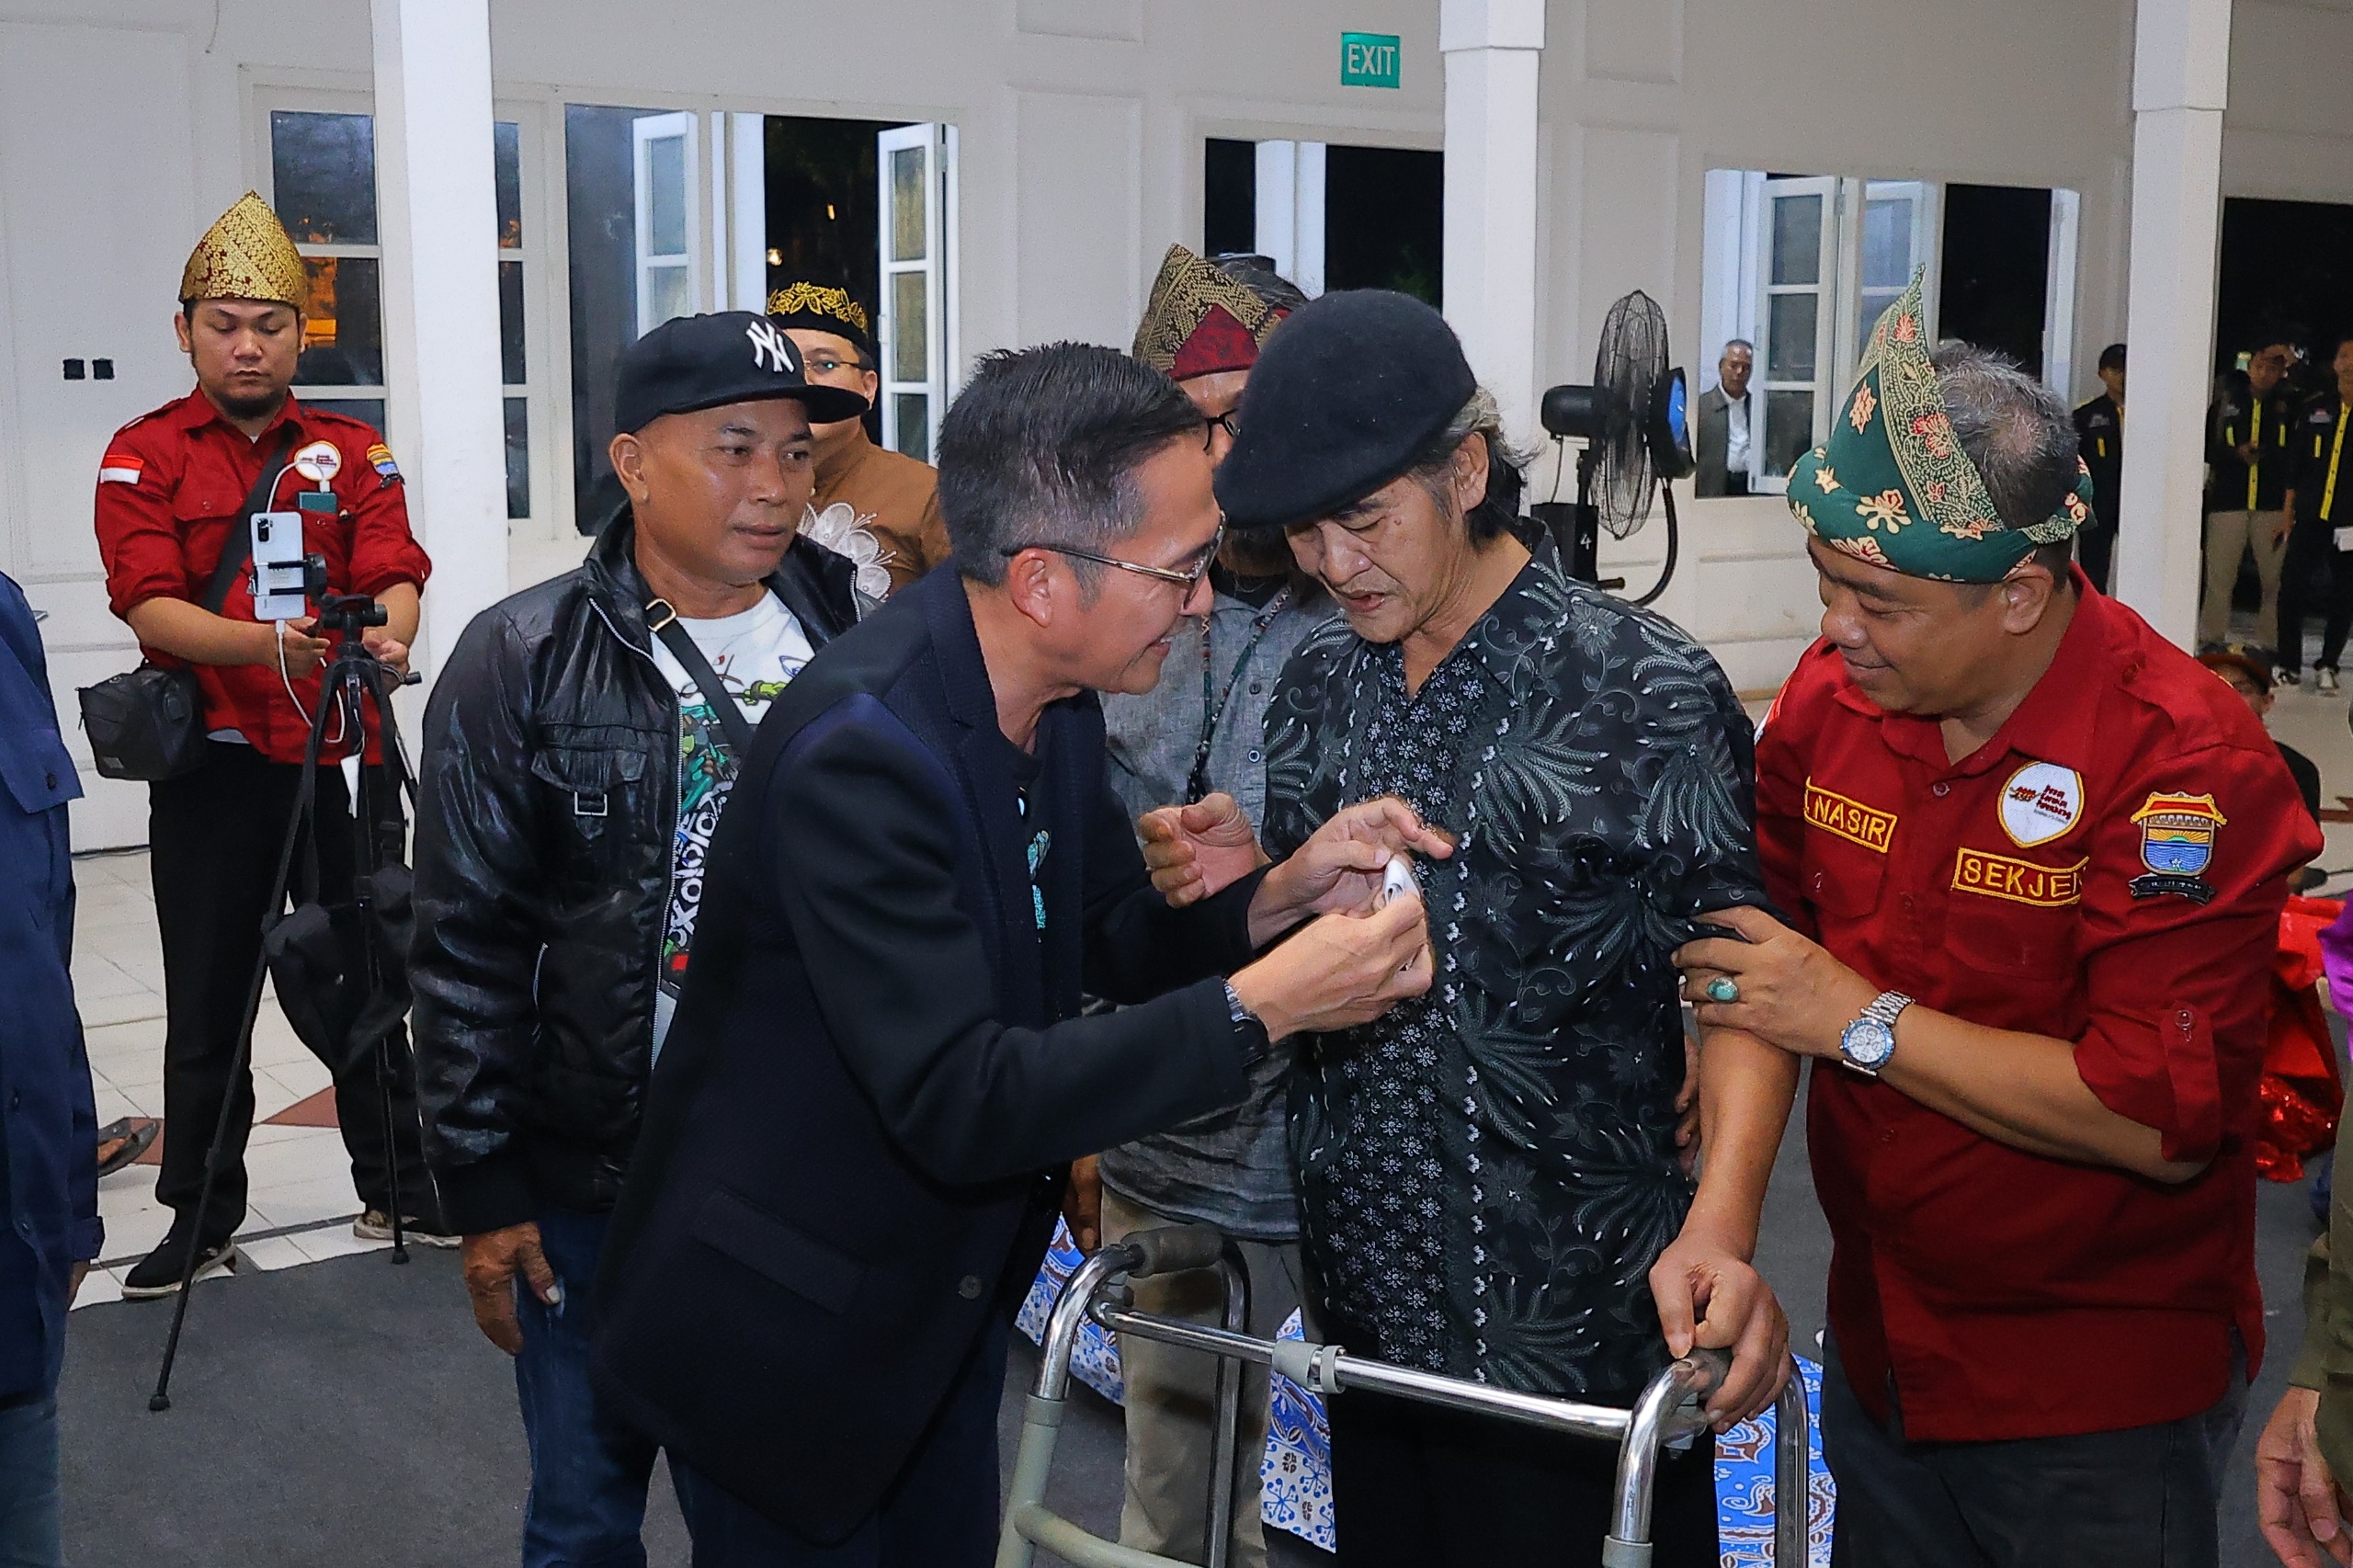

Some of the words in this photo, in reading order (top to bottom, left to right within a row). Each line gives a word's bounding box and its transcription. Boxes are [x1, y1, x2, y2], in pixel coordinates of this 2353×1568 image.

[1348, 43, 1395, 76] EXIT
[745, 320, 795, 373] NY
[1580, 532, 1593, 550] 4
[1814, 794, 1886, 845] NASIR
